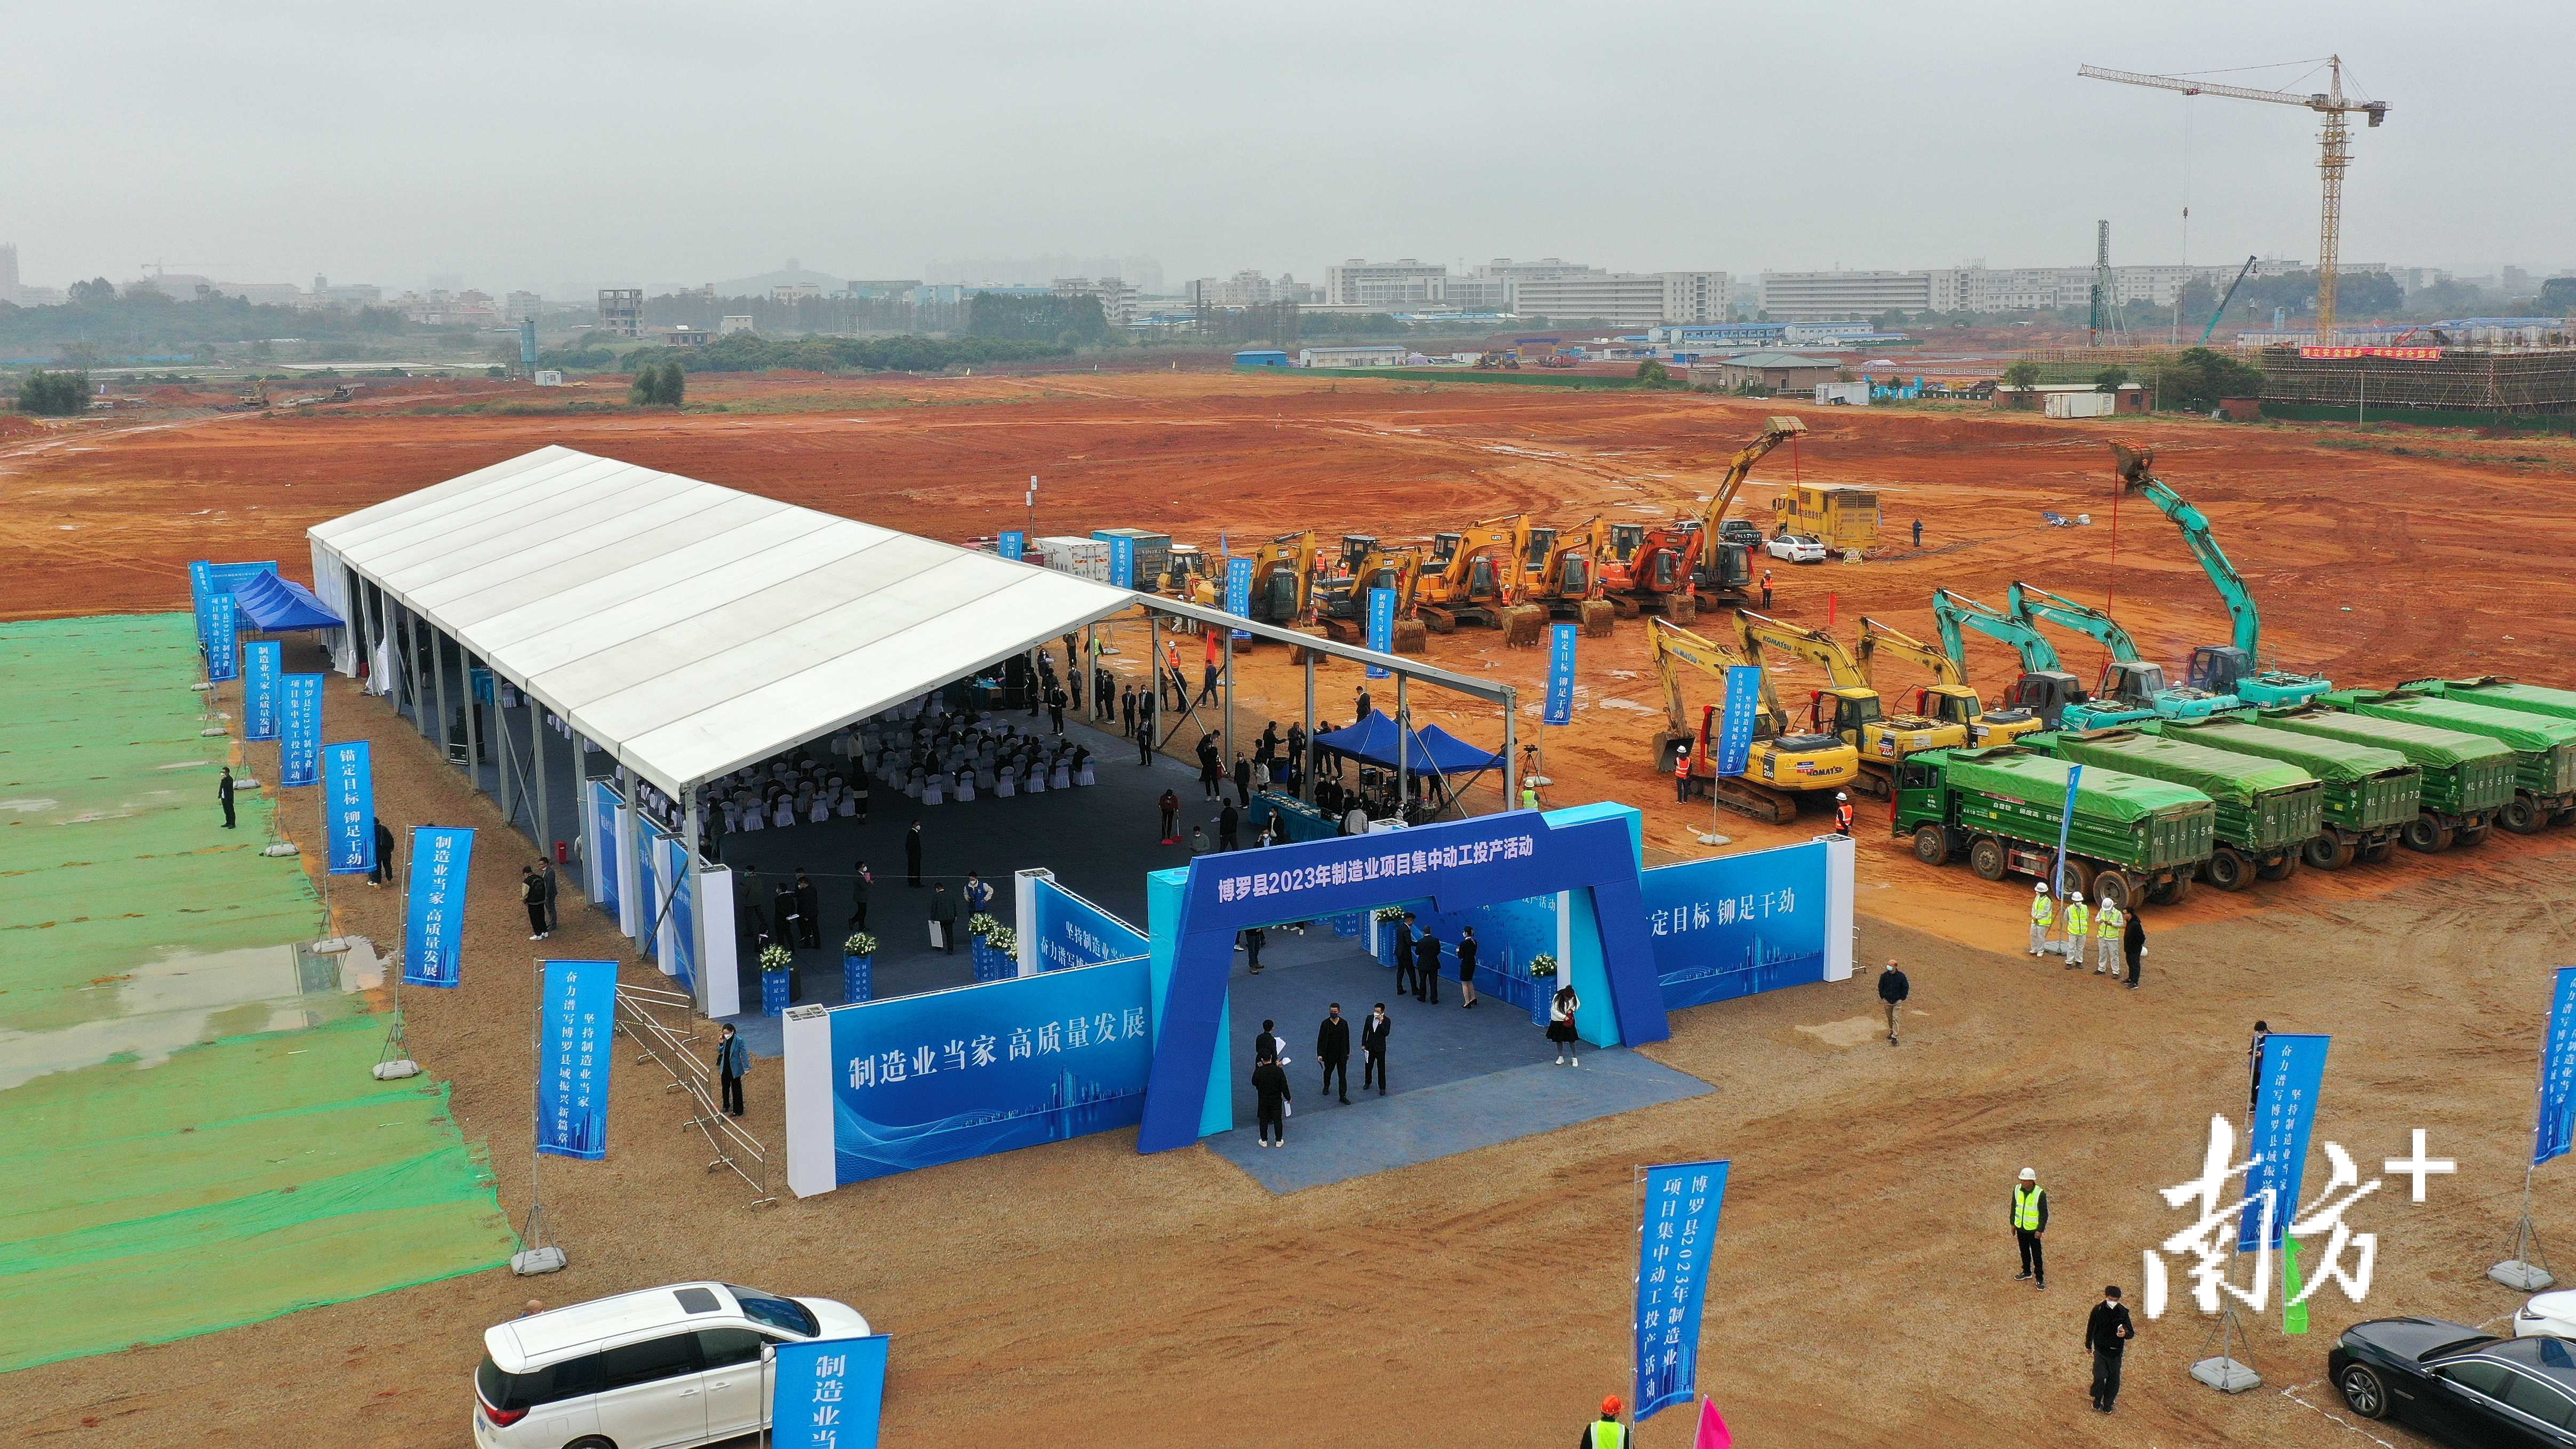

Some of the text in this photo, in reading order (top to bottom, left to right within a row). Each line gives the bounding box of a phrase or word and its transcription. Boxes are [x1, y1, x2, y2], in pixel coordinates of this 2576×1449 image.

[1553, 629, 1570, 719] 锚定目标 铆足干劲
[1672, 646, 1698, 664] KOMATSU
[1762, 635, 1792, 651] KOMATSU
[258, 646, 270, 734] 制造业当家 高质量发展
[290, 679, 301, 780] 项目集中动工投产活动
[303, 679, 314, 768] 博罗县2023年制造业
[339, 749, 362, 866] 锚定目标 铆足干劲
[422, 835, 453, 978] 制造业当家 高质量发展
[1218, 834, 1534, 903] 博罗县2023年制造业项目集中动工投产活动
[1645, 887, 1795, 938] 定目标 铆足干劲
[1066, 920, 1125, 961] 坚持制造业当
[556, 970, 578, 1144] 奋力谱写博罗县域振兴新篇章
[577, 1012, 595, 1108] 坚持制造业当家
[849, 1006, 1146, 1090] 制造业当家 高质量发展
[2278, 1088, 2302, 1191] 坚持制造业当家
[1644, 1177, 1683, 1399] 项目集中动工投产活动
[1663, 1175, 1709, 1367] 博罗县2023年制造业
[810, 1354, 847, 1449] 制造业当
